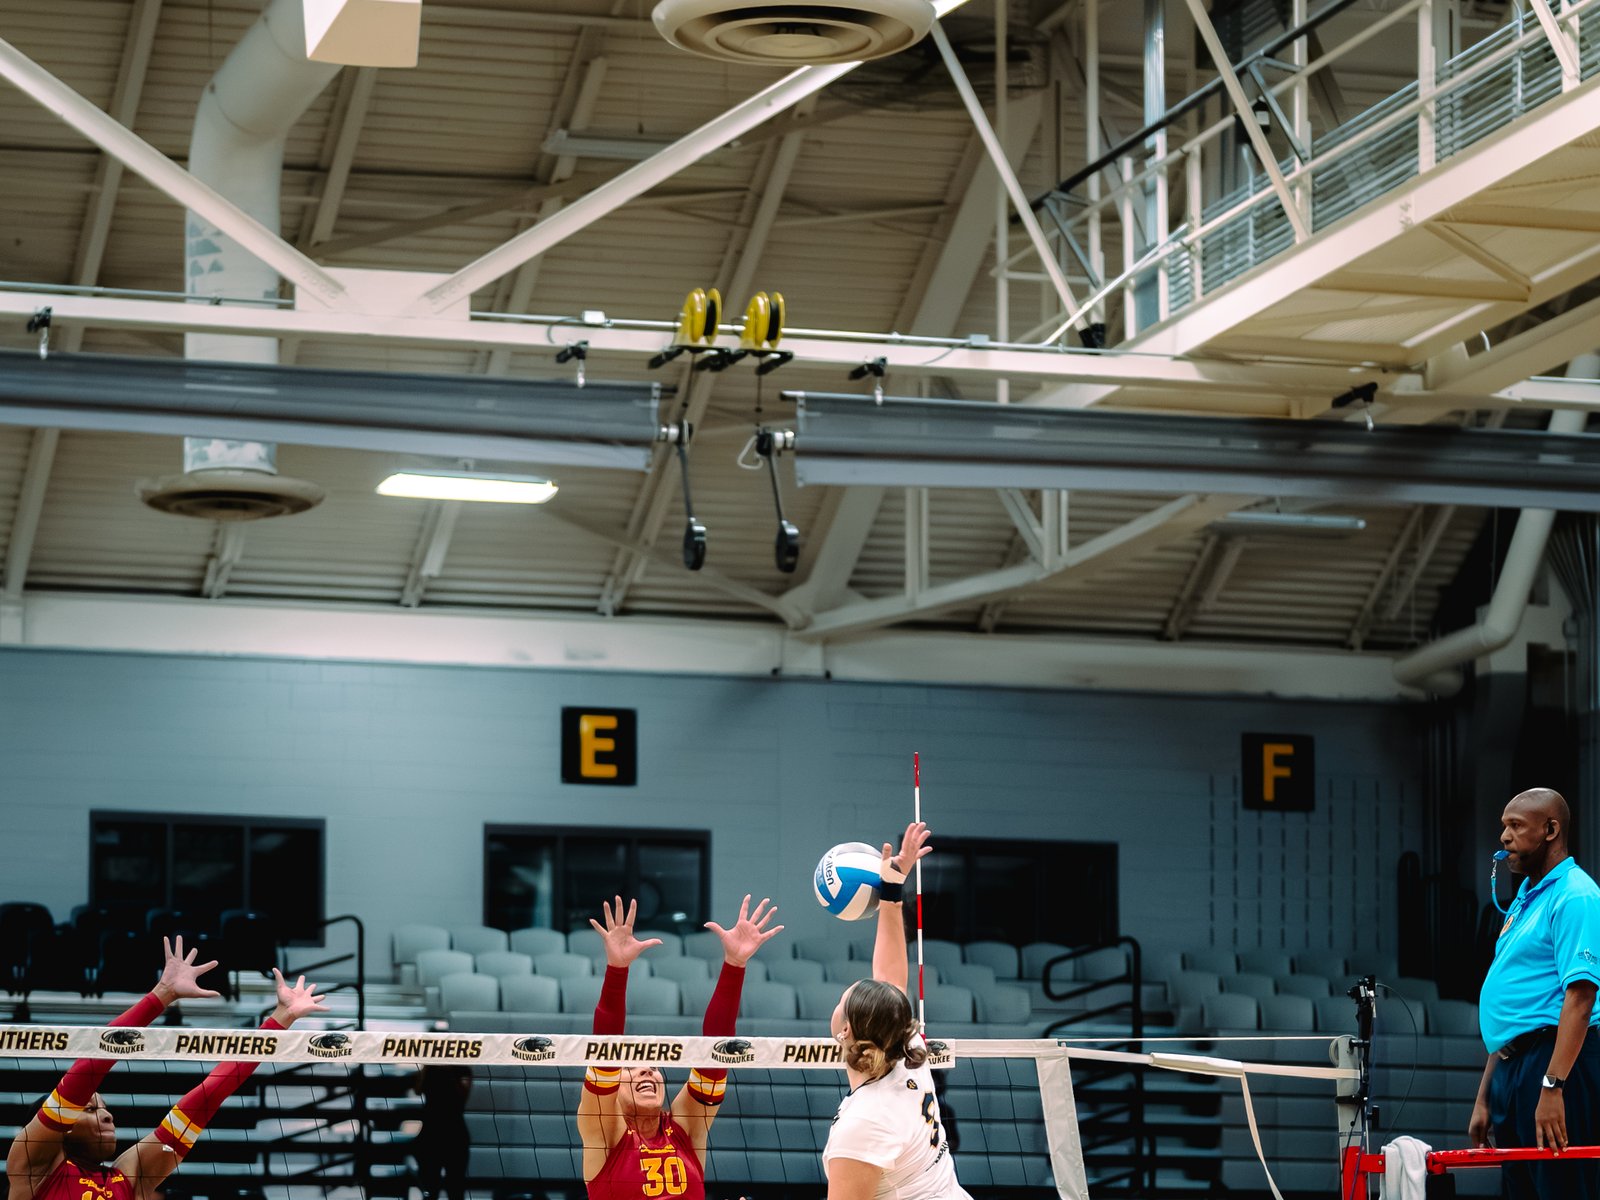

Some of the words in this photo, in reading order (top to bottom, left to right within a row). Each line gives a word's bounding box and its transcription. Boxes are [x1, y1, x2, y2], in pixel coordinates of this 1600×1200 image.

[579, 714, 618, 778] E
[1263, 743, 1294, 801] F
[99, 1041, 145, 1054] MILWAUKEE
[175, 1035, 278, 1055] PANTHERS
[307, 1046, 352, 1059] MILWAUKEE
[382, 1038, 483, 1058] PANTHERS
[585, 1042, 684, 1062] PANTHERS
[783, 1044, 846, 1063] PANTH
[511, 1049, 556, 1062] MILWAUKEE
[711, 1052, 755, 1064] MILWAUKEE
[640, 1156, 687, 1196] 30
